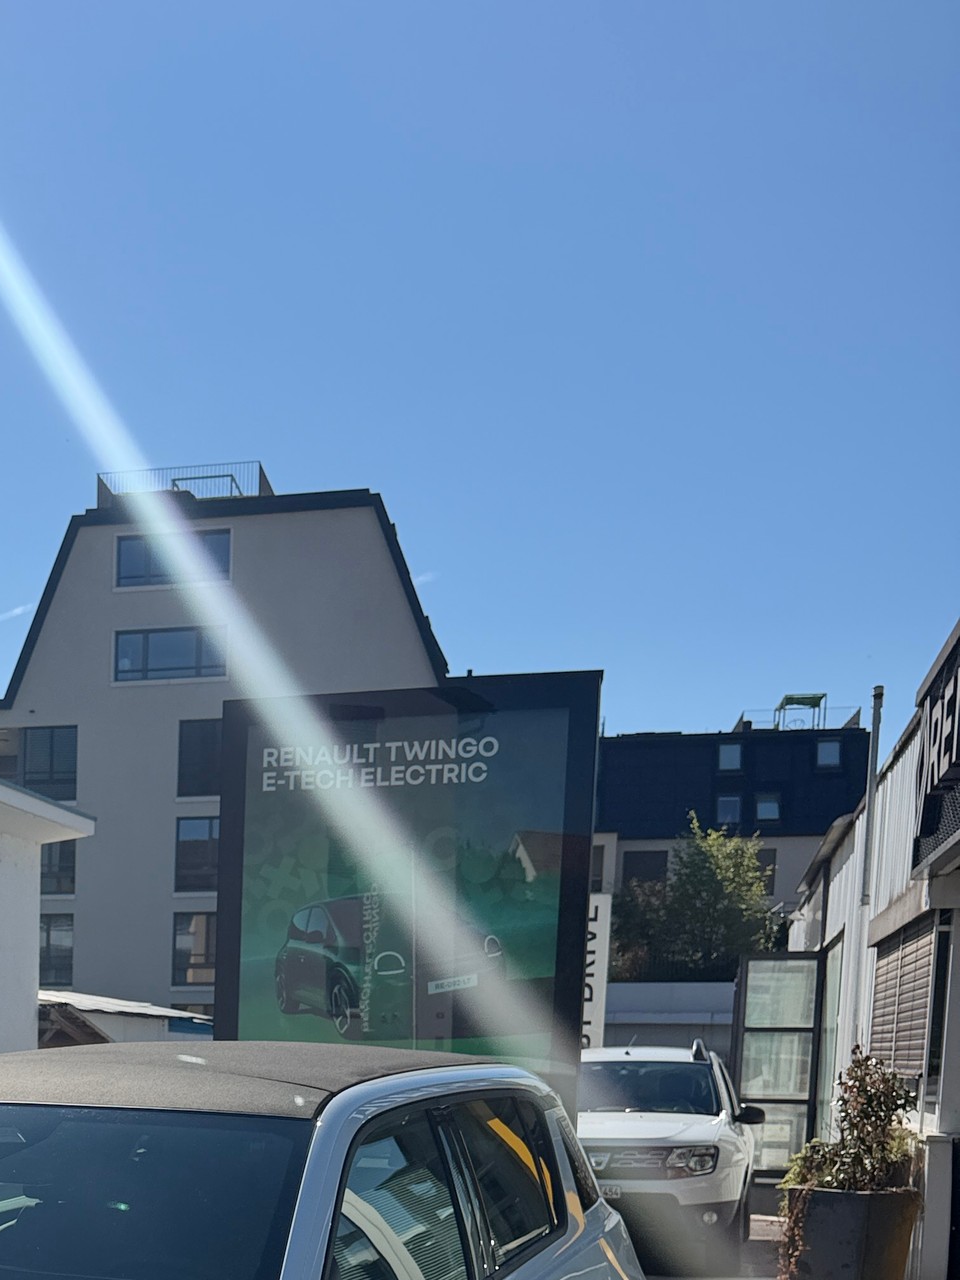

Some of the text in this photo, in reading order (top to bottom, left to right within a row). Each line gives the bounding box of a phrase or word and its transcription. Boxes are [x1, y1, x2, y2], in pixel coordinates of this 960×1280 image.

[262, 736, 499, 768] RENAULT TWINGO
[262, 761, 488, 792] E-TECH ELECTRIC
